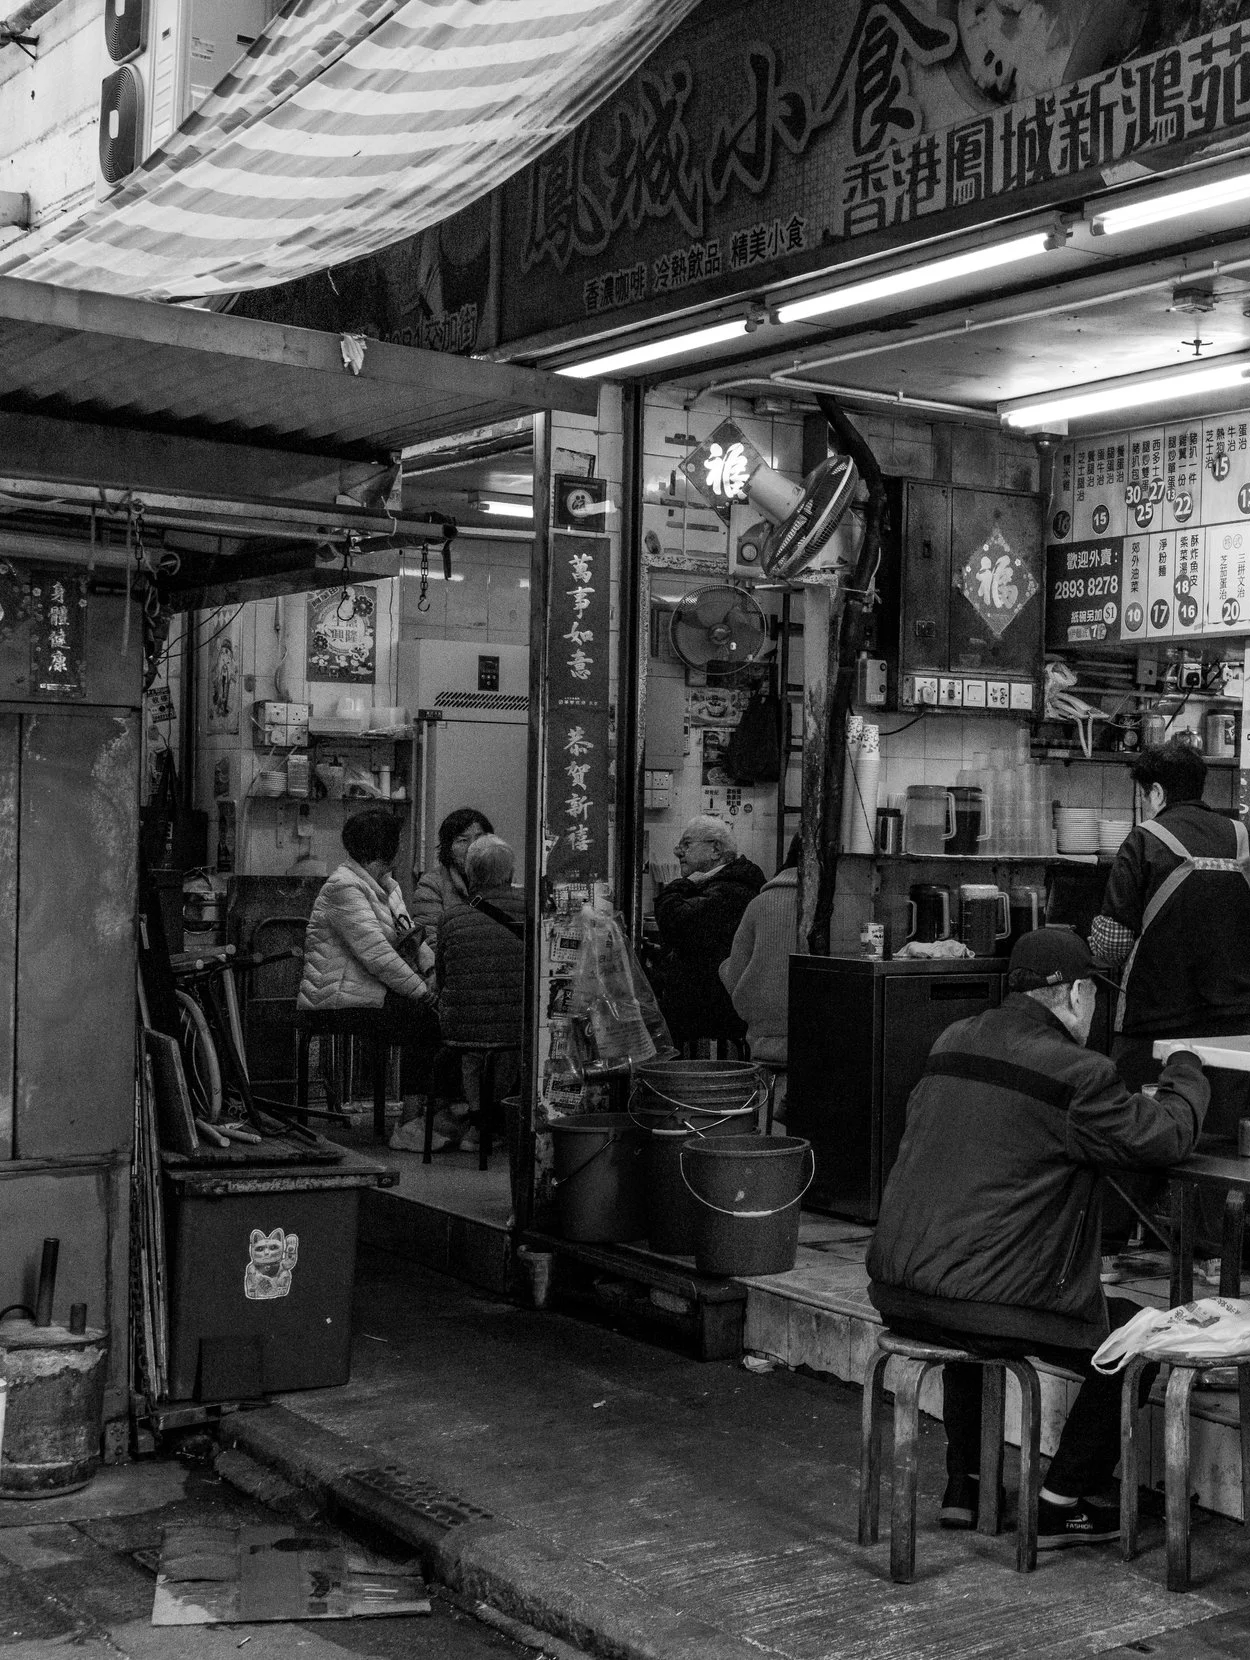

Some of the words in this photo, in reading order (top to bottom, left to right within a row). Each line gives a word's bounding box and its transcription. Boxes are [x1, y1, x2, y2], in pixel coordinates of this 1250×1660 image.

[585, 265, 646, 314] 香濃咖啡
[653, 241, 722, 290] 冷熱飲品
[730, 215, 805, 268] 精美小食
[1213, 456, 1229, 477] 15
[1125, 485, 1141, 505] 30
[1149, 480, 1165, 501] 27
[1136, 502, 1153, 522] 25
[1175, 497, 1192, 516] 22
[1093, 511, 1107, 527] 15
[976, 555, 1019, 609] 福
[1054, 578, 1085, 600] 2893
[1087, 574, 1119, 597] 8278
[1175, 580, 1189, 594] 18
[562, 553, 596, 680] 萬事如意
[1127, 608, 1141, 622] 10
[1153, 605, 1168, 623] 17
[1180, 604, 1196, 618] 16
[1223, 600, 1239, 621] 20
[563, 725, 595, 851] 恭賀新禧
